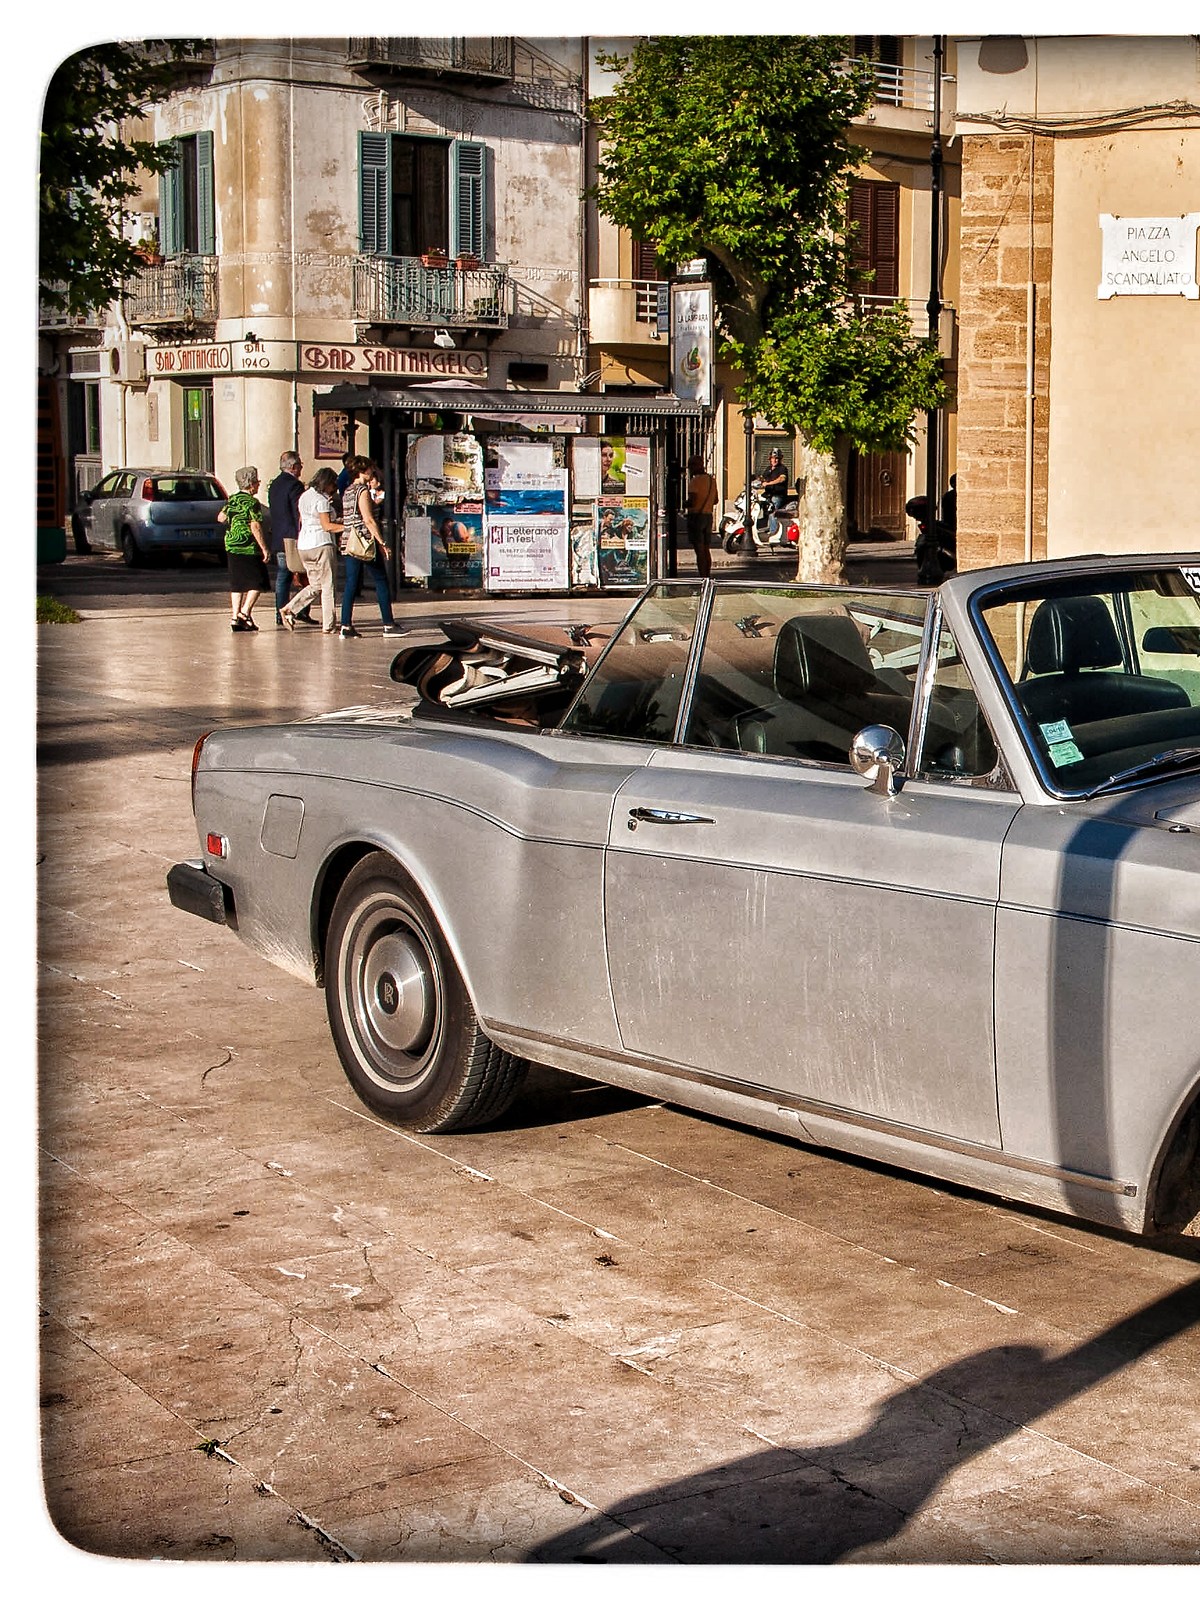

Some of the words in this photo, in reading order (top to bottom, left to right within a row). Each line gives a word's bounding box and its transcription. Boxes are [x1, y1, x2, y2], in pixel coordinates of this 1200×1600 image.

[1127, 227, 1171, 240] PIAZZA
[1121, 249, 1176, 263] ANGELO
[1106, 272, 1192, 286] SCANDALIATO
[244, 343, 266, 354] DAL
[155, 350, 175, 373] BAR
[176, 347, 230, 371] SANTANGELO
[241, 357, 271, 369] 1940
[303, 346, 356, 371] BAR
[361, 349, 488, 376] SANTANGELO
[506, 526, 559, 536] Letterando
